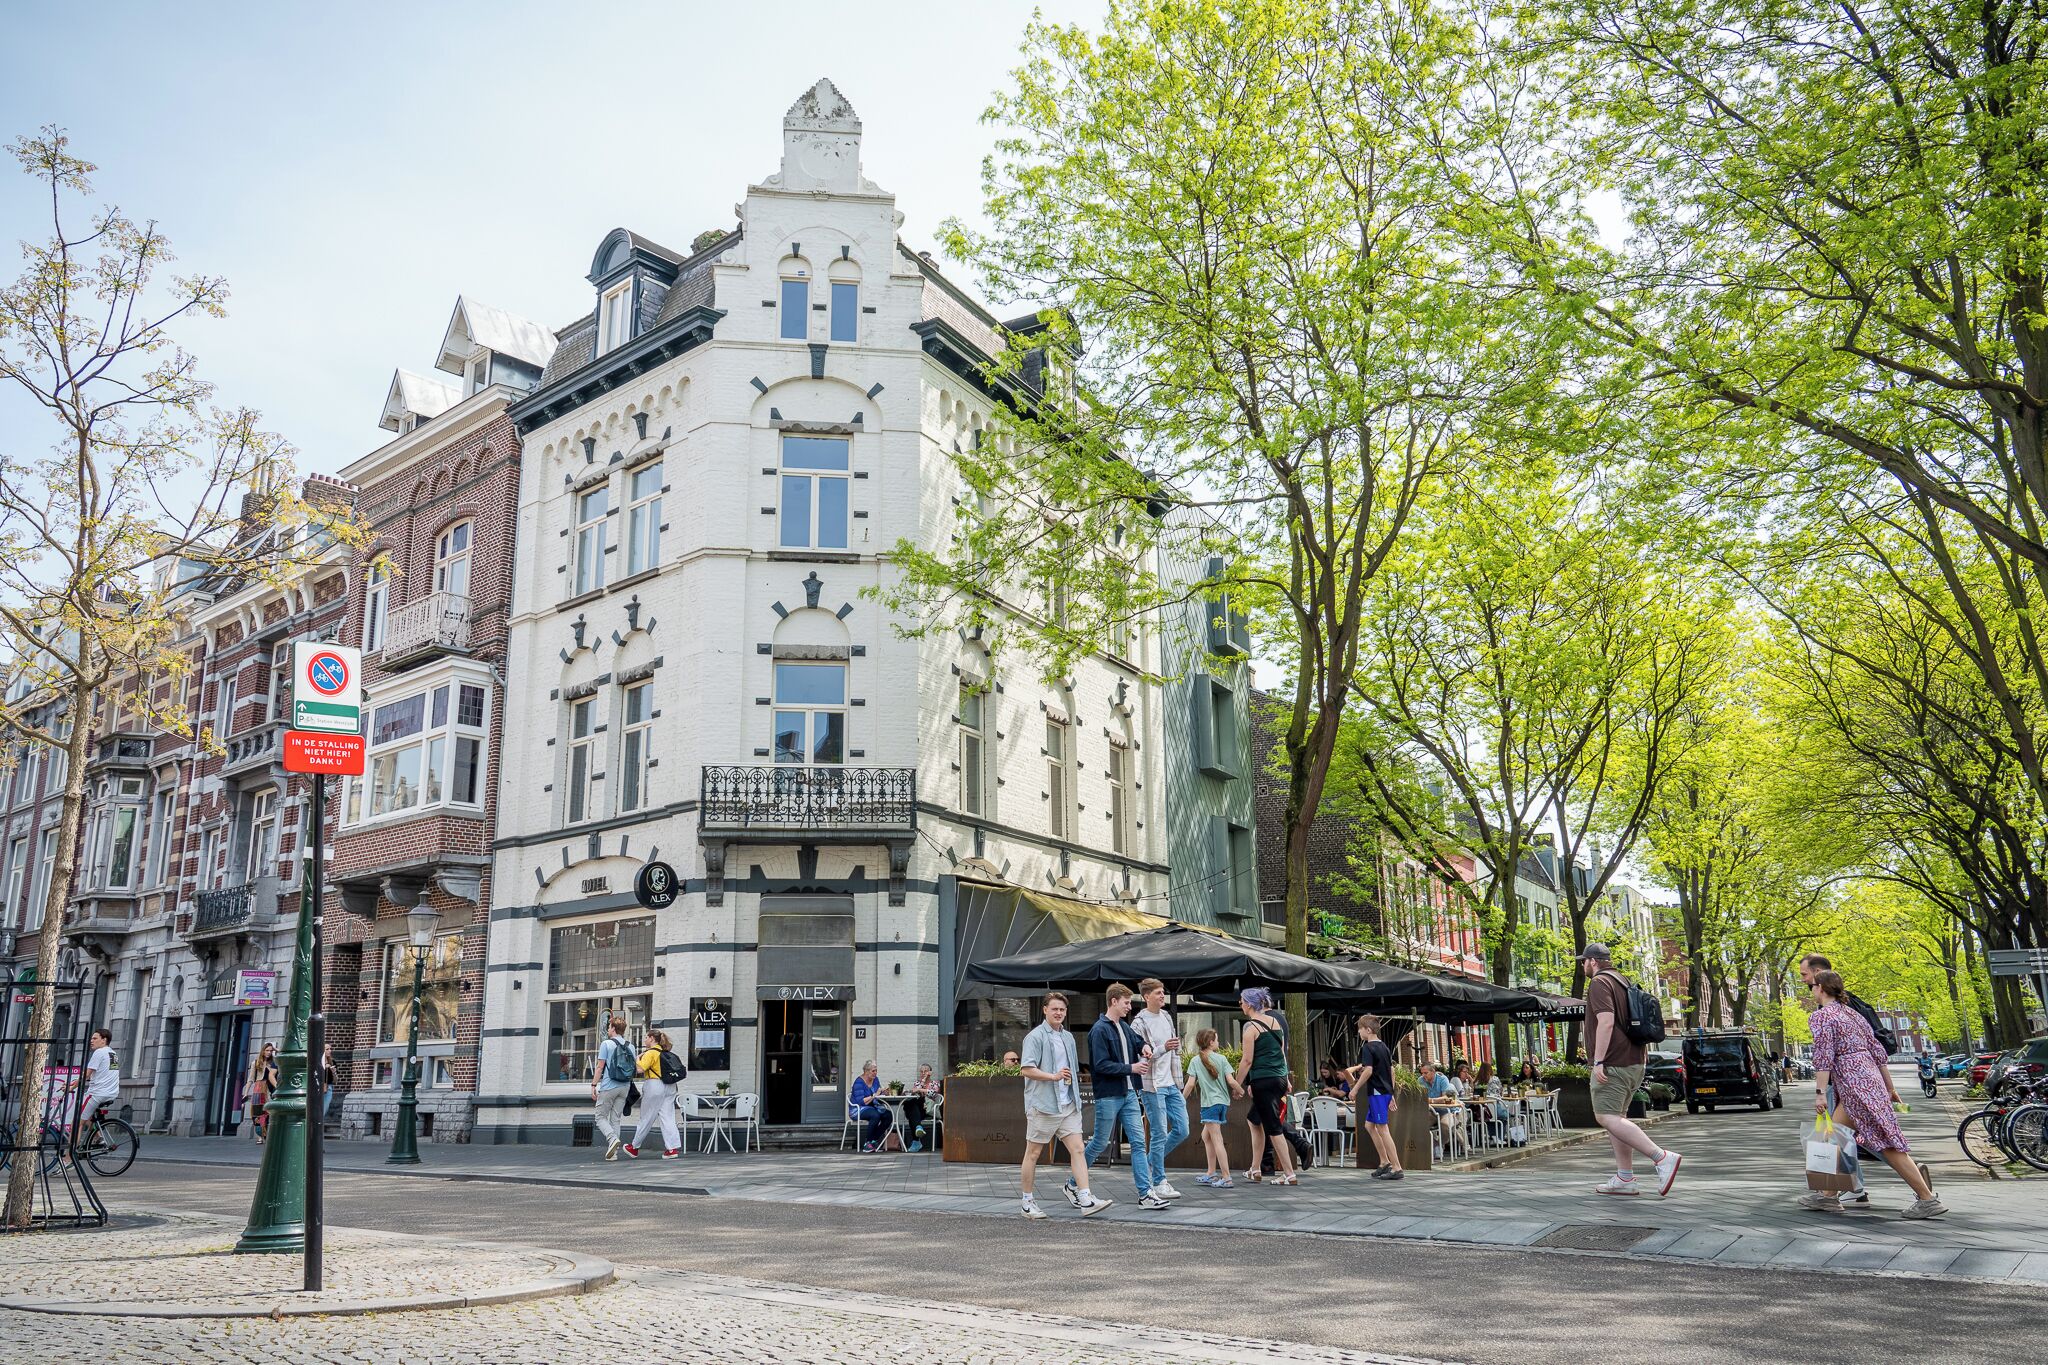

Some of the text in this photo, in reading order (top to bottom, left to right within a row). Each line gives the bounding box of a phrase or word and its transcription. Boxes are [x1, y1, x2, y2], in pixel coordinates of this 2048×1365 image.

[318, 740, 359, 749] STALLING
[327, 750, 351, 758] HIER!
[310, 757, 333, 765] DANK
[650, 894, 671, 903] ALEX
[792, 987, 834, 1000] ALEX
[694, 1012, 727, 1022] ALEX
